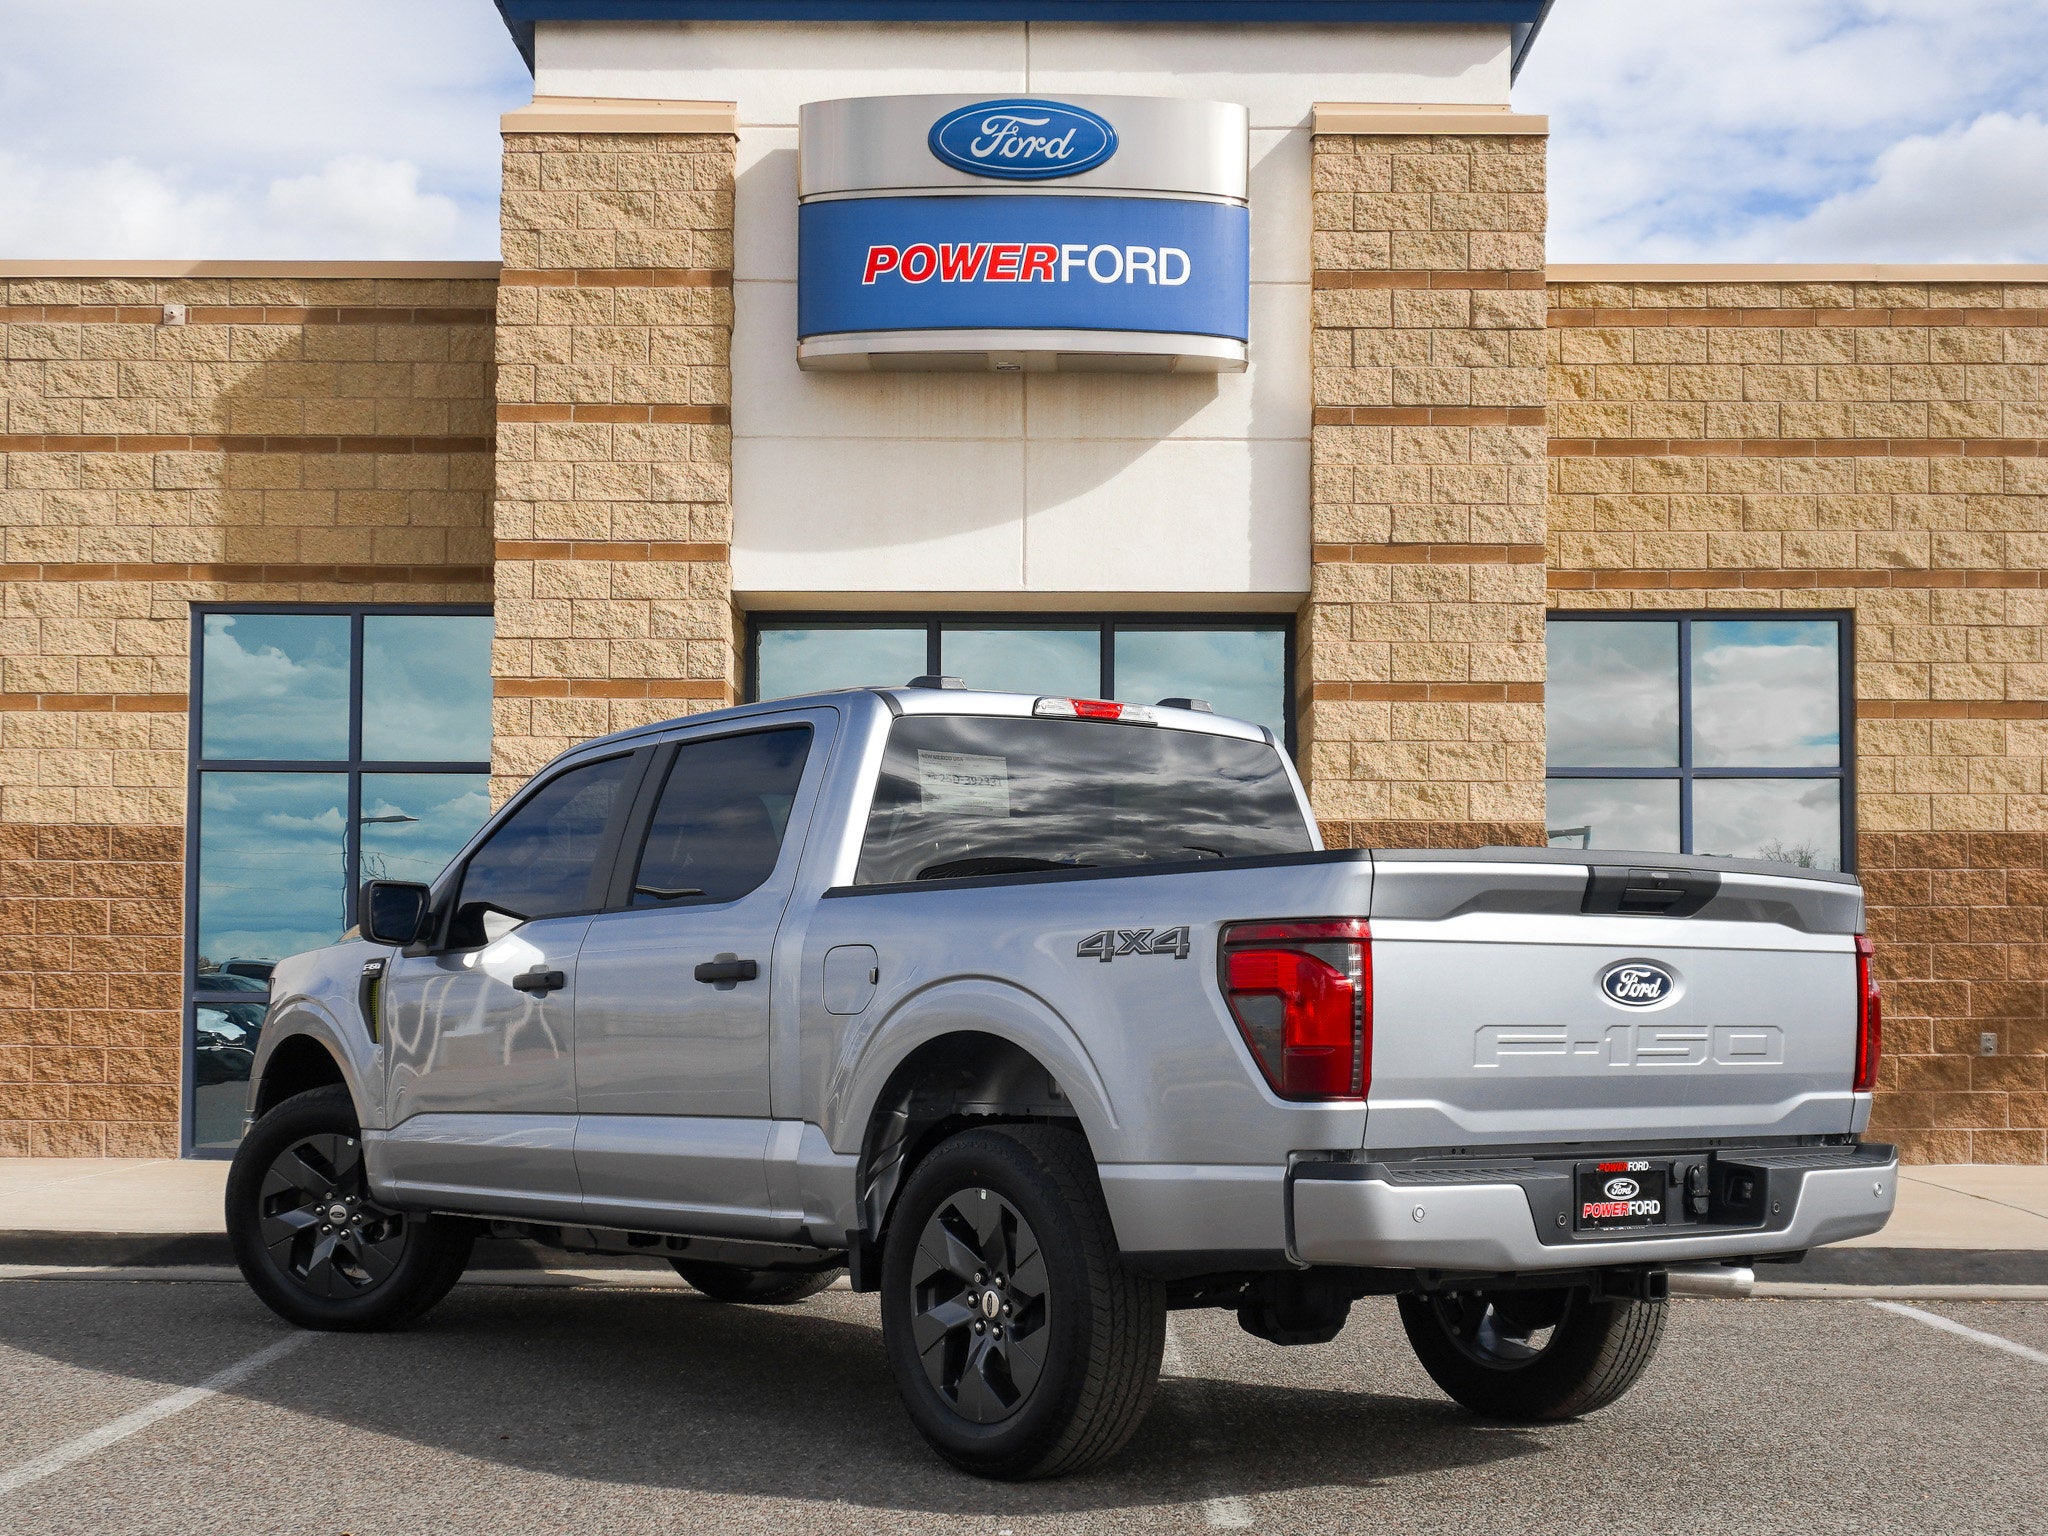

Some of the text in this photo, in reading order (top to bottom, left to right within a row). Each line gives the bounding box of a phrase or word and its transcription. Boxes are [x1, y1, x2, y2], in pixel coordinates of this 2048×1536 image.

[970, 115, 1077, 159] Ford
[1616, 969, 1663, 999] Ford
[1473, 1024, 1784, 1067] F-150
[1611, 1182, 1633, 1196] Ford
